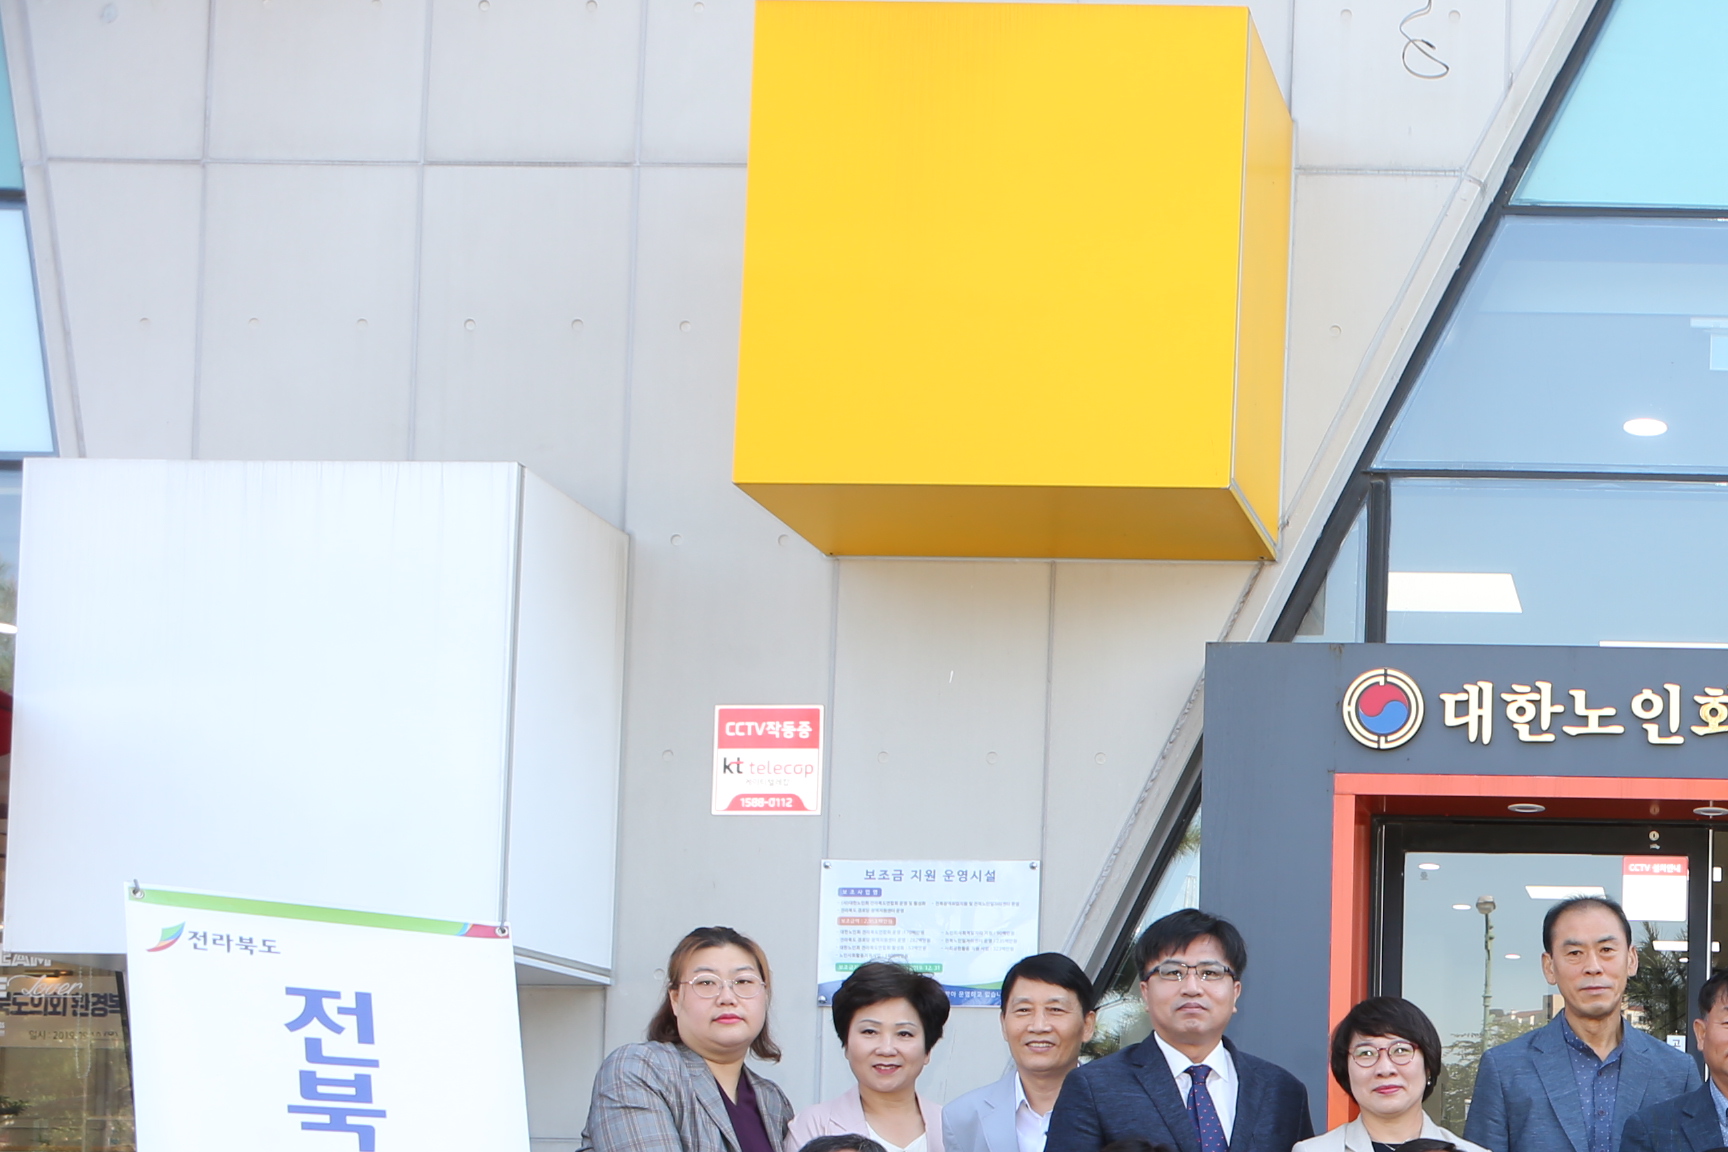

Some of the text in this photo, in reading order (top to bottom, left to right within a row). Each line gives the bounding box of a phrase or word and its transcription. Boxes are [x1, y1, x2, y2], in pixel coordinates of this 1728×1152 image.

[723, 757, 814, 778] kt telecop
[739, 797, 793, 808] 1588-0112
[1628, 863, 1651, 872] CCTV
[864, 869, 996, 883] 보조금 지원 운영시설
[188, 931, 281, 955] 전라북도
